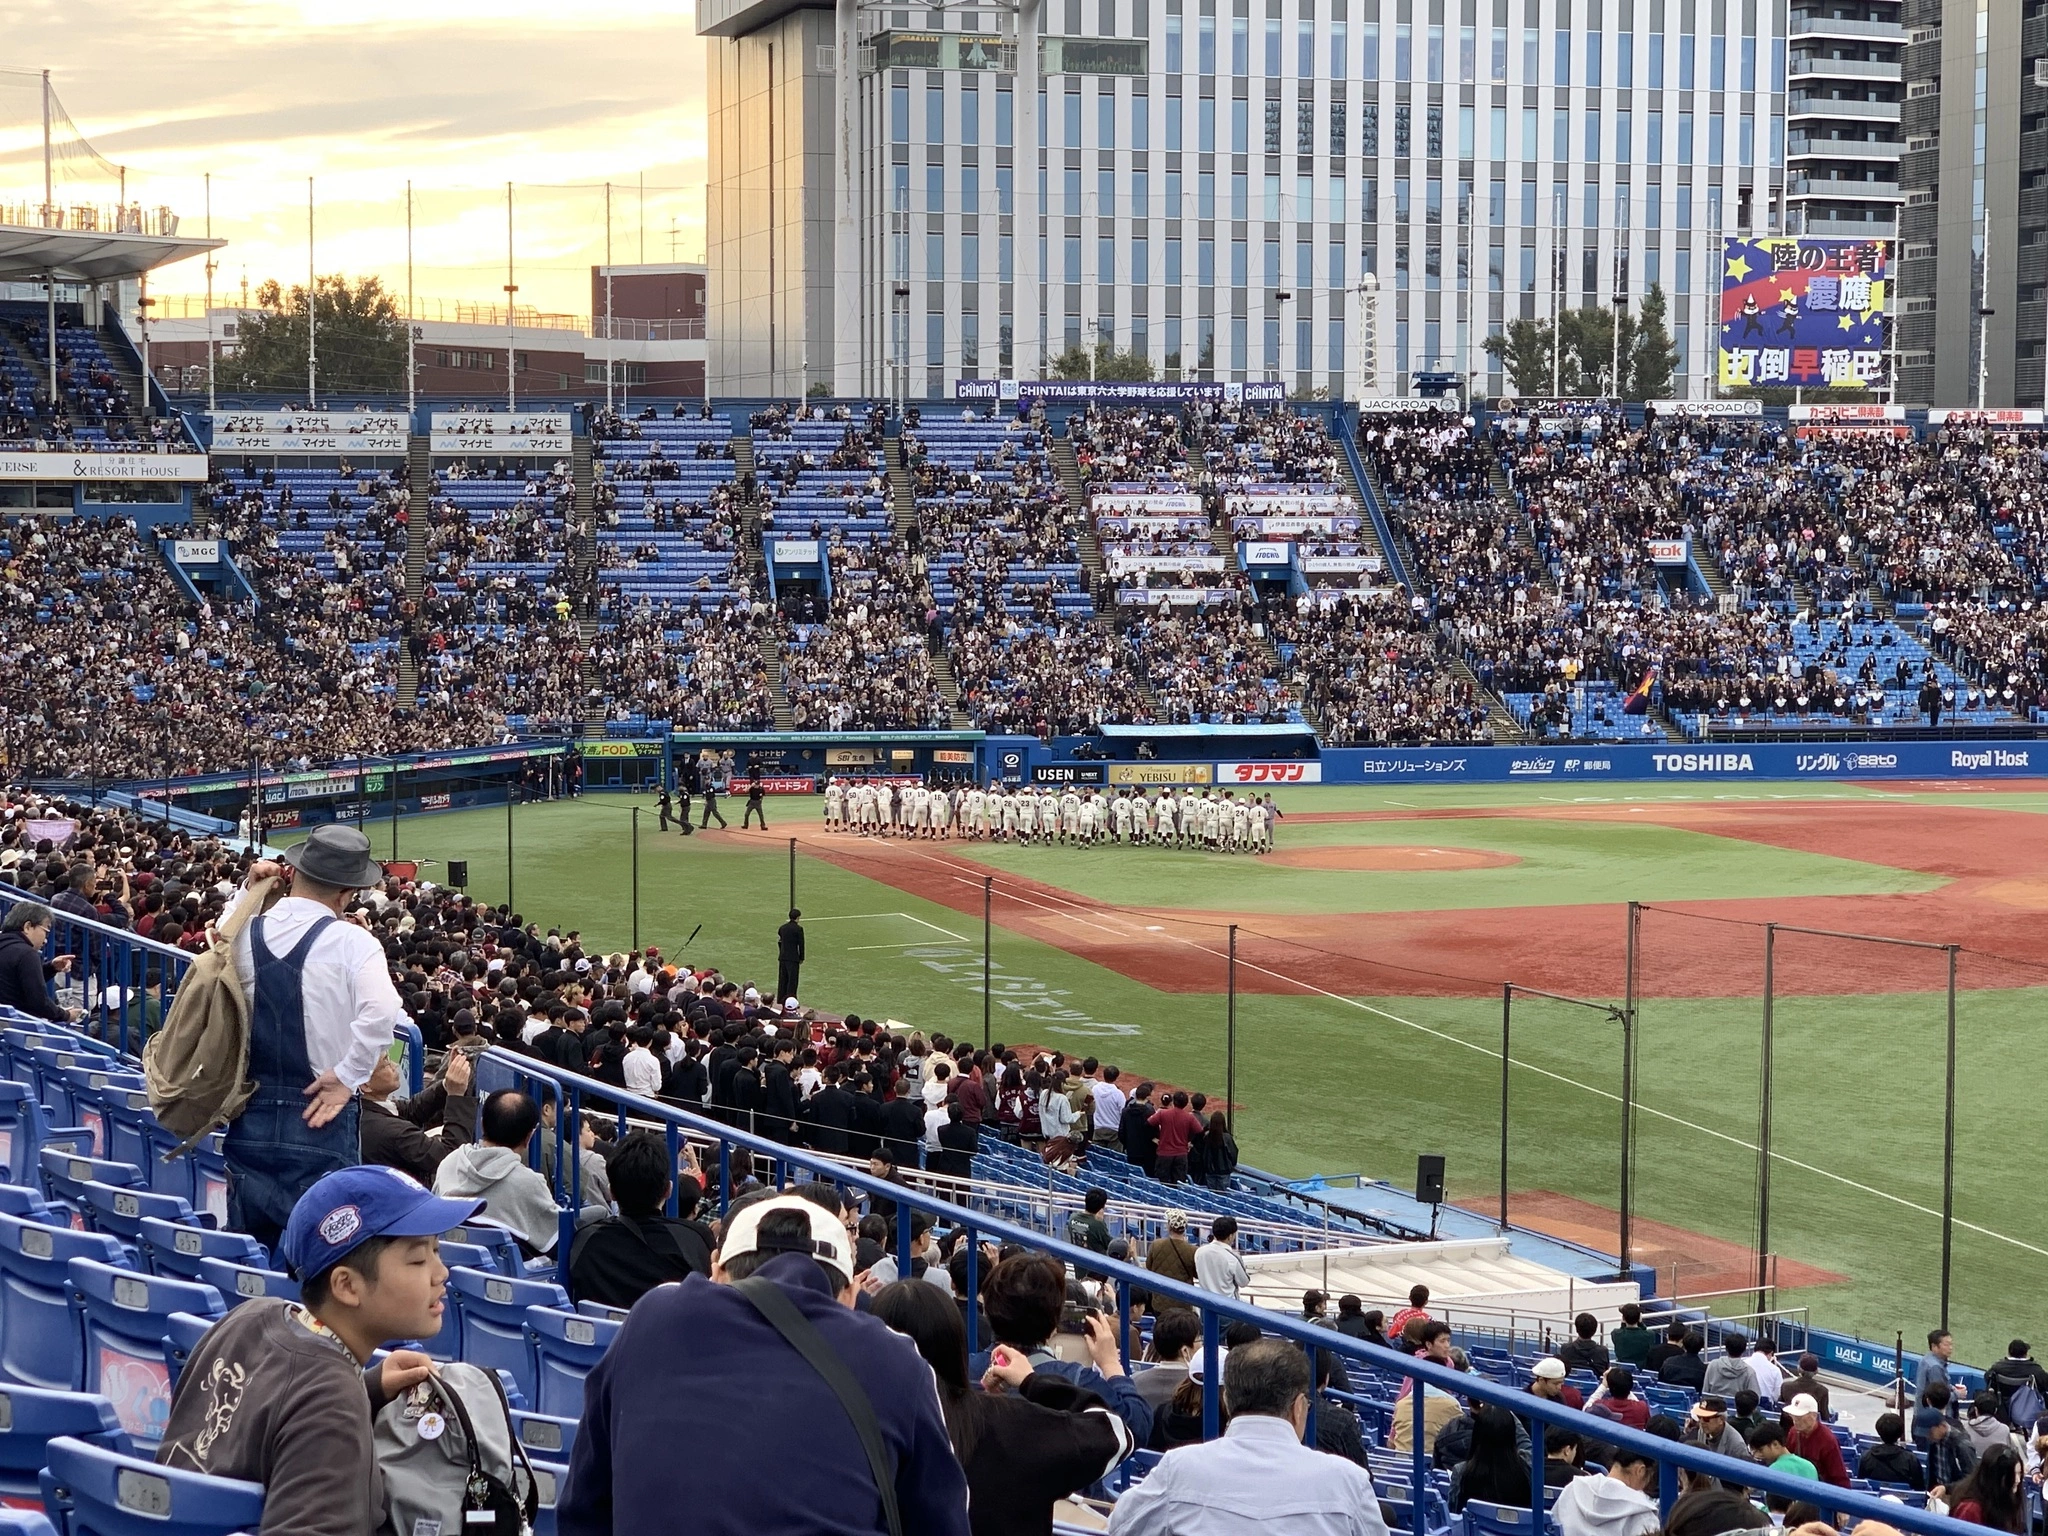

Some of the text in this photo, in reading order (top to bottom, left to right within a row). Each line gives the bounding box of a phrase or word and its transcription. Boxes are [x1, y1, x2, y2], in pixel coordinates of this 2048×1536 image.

[1771, 243, 1882, 272] 陸の王者
[1806, 276, 1872, 311] 慶應
[1728, 345, 1881, 382] 打倒早稲田
[959, 382, 998, 398] CHINTAI
[1019, 385, 1223, 398] CHINTAIは東京六大学野球を応援しています
[1245, 384, 1283, 400] CHINTAI
[1364, 402, 1438, 410] JACKROAD
[230, 416, 265, 426] マイナビ
[295, 416, 329, 426] マイナビ
[365, 417, 399, 427] マイナビ
[460, 418, 493, 427] マイナビ
[530, 418, 563, 427] マイナビ
[236, 438, 270, 448] マイナビ
[302, 438, 336, 448] マイナビ
[367, 438, 402, 448] マイナビ
[459, 439, 493, 449] マイナビ
[530, 439, 563, 449] マイナビ
[90, 466, 136, 476] RESORT
[141, 467, 181, 477] HOUSE
[191, 547, 216, 556] MGC
[784, 548, 817, 556] アンリミテッド
[940, 752, 968, 761] 能美防災
[1952, 750, 2029, 770] Royal Host
[1364, 759, 1467, 773] 日立ソリューションズ
[1511, 757, 1555, 770] ゆうパック
[1584, 760, 1611, 770] 郵便局
[1652, 754, 1754, 771] TOSHIBA
[1796, 753, 1840, 771] リングル
[1037, 769, 1074, 780] USEN
[1139, 773, 1176, 782] YEBISU
[1234, 764, 1304, 781] タフマン
[265, 792, 286, 802] UACJ
[1835, 1345, 1862, 1360] UACJ
[1872, 1355, 1897, 1370] UAC
